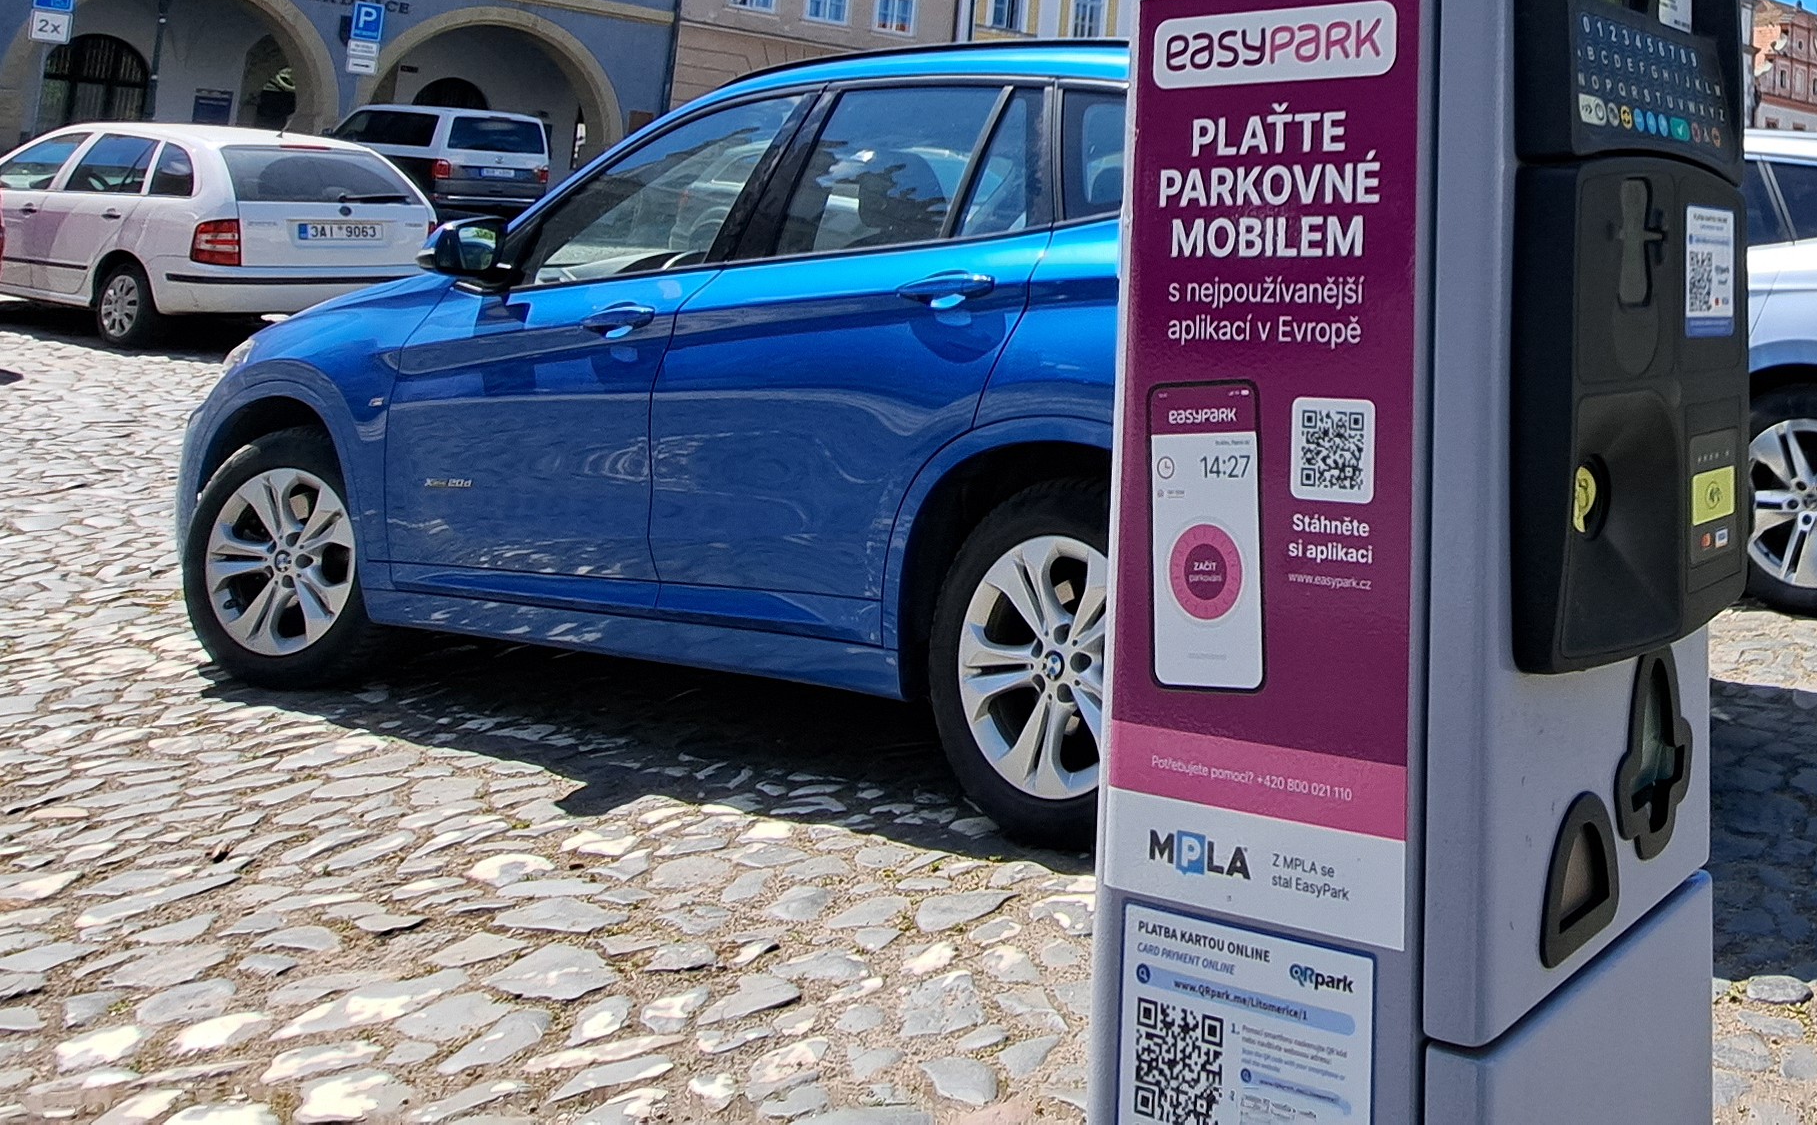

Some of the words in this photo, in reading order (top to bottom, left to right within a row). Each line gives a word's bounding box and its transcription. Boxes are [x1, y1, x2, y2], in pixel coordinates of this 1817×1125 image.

[37, 19, 61, 35] 2x
[358, 6, 377, 28] P
[1583, 16, 1590, 33] 0
[1597, 21, 1603, 37] 1
[1610, 26, 1617, 42] 2
[1622, 30, 1629, 45] 3
[1636, 34, 1642, 49] 4
[1647, 38, 1653, 53] 5
[1658, 42, 1664, 57] 6
[1669, 45, 1675, 59] 7
[1680, 49, 1686, 64] 8
[1691, 52, 1697, 67] 9
[1191, 102, 1346, 157] PLAŤTE
[1159, 150, 1381, 208] PARKOVNÉ
[345, 226, 377, 238] 9063
[1170, 215, 1364, 258] MOBILEM
[1168, 283, 1180, 303] s
[1187, 276, 1365, 309] nejpoužívanější
[1168, 314, 1251, 345] aplikací
[1258, 323, 1270, 341] v
[1279, 316, 1362, 349] Evropě
[1200, 455, 1250, 478] 14:27
[1292, 513, 1370, 537] Stáhněte
[1288, 539, 1303, 557] si
[1306, 542, 1373, 564] aplikaci
[1288, 573, 1372, 590] www.easypark.cz
[1257, 776, 1285, 790] +420
[1287, 779, 1309, 794] 800
[1311, 782, 1331, 798] 021
[1334, 787, 1352, 801] 110
[1149, 829, 1251, 881] MPLA
[1272, 853, 1280, 868] Z
[1283, 855, 1318, 875] MPLA
[1321, 864, 1335, 878] se
[1272, 874, 1292, 889] stal
[1295, 876, 1350, 901] EasyPark
[1138, 920, 1178, 942] PLATBA
[1180, 929, 1225, 952] KARTOU
[1227, 942, 1271, 963] ONLINE
[1137, 941, 1159, 957] CARD
[1161, 947, 1200, 967] PAYMENT
[1202, 958, 1236, 976] ONLINE
[1289, 963, 1354, 994] QRpark
